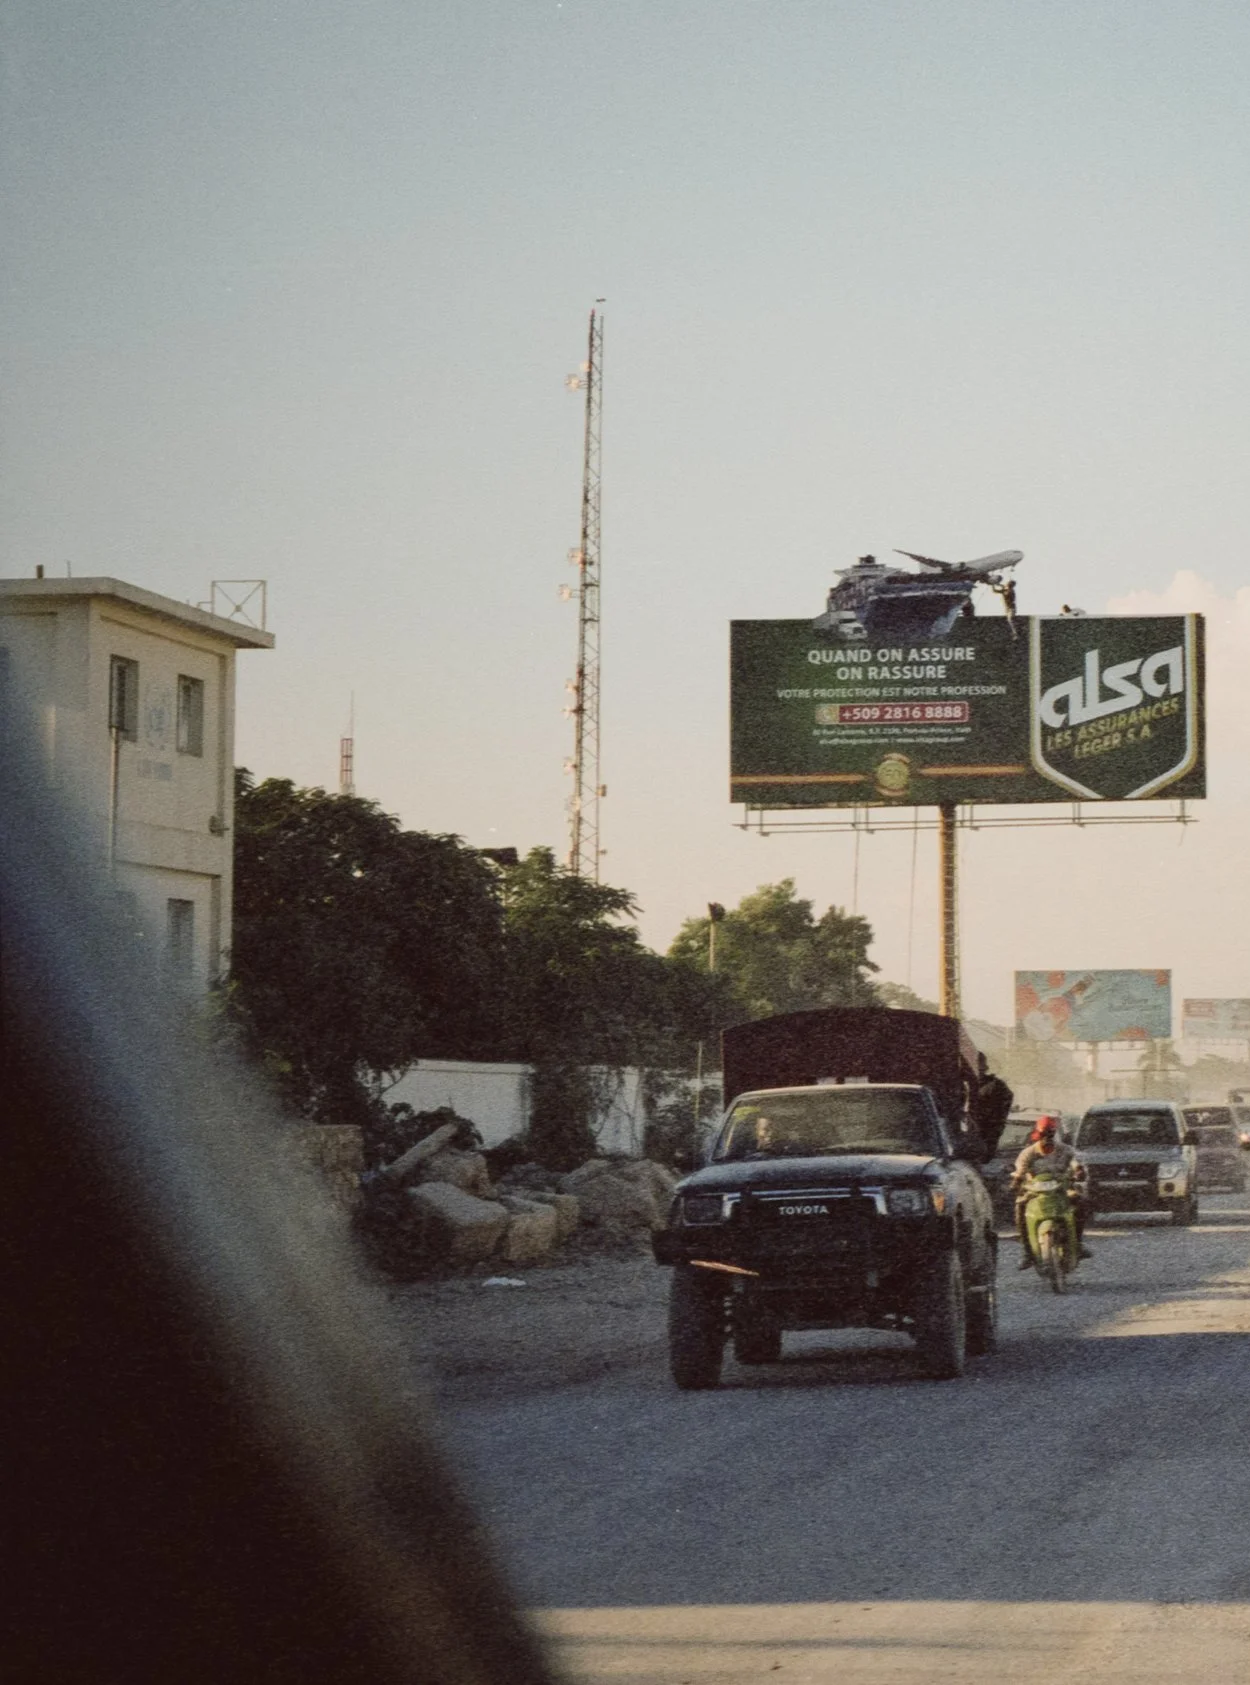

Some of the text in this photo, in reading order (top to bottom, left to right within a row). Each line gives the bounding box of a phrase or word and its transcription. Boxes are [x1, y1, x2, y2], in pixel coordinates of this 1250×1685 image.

[807, 647, 977, 665] QUAND ON ASSURE
[836, 665, 948, 680] ON RASSURE
[776, 685, 1007, 699] VOTRE PROTECTION EST NOTRE PROFESSION
[1038, 645, 1184, 728] alsa
[842, 705, 962, 720] +509 2816 8888
[1047, 697, 1180, 751] LES ASSURANCES
[779, 1204, 829, 1215] TOYOTA
